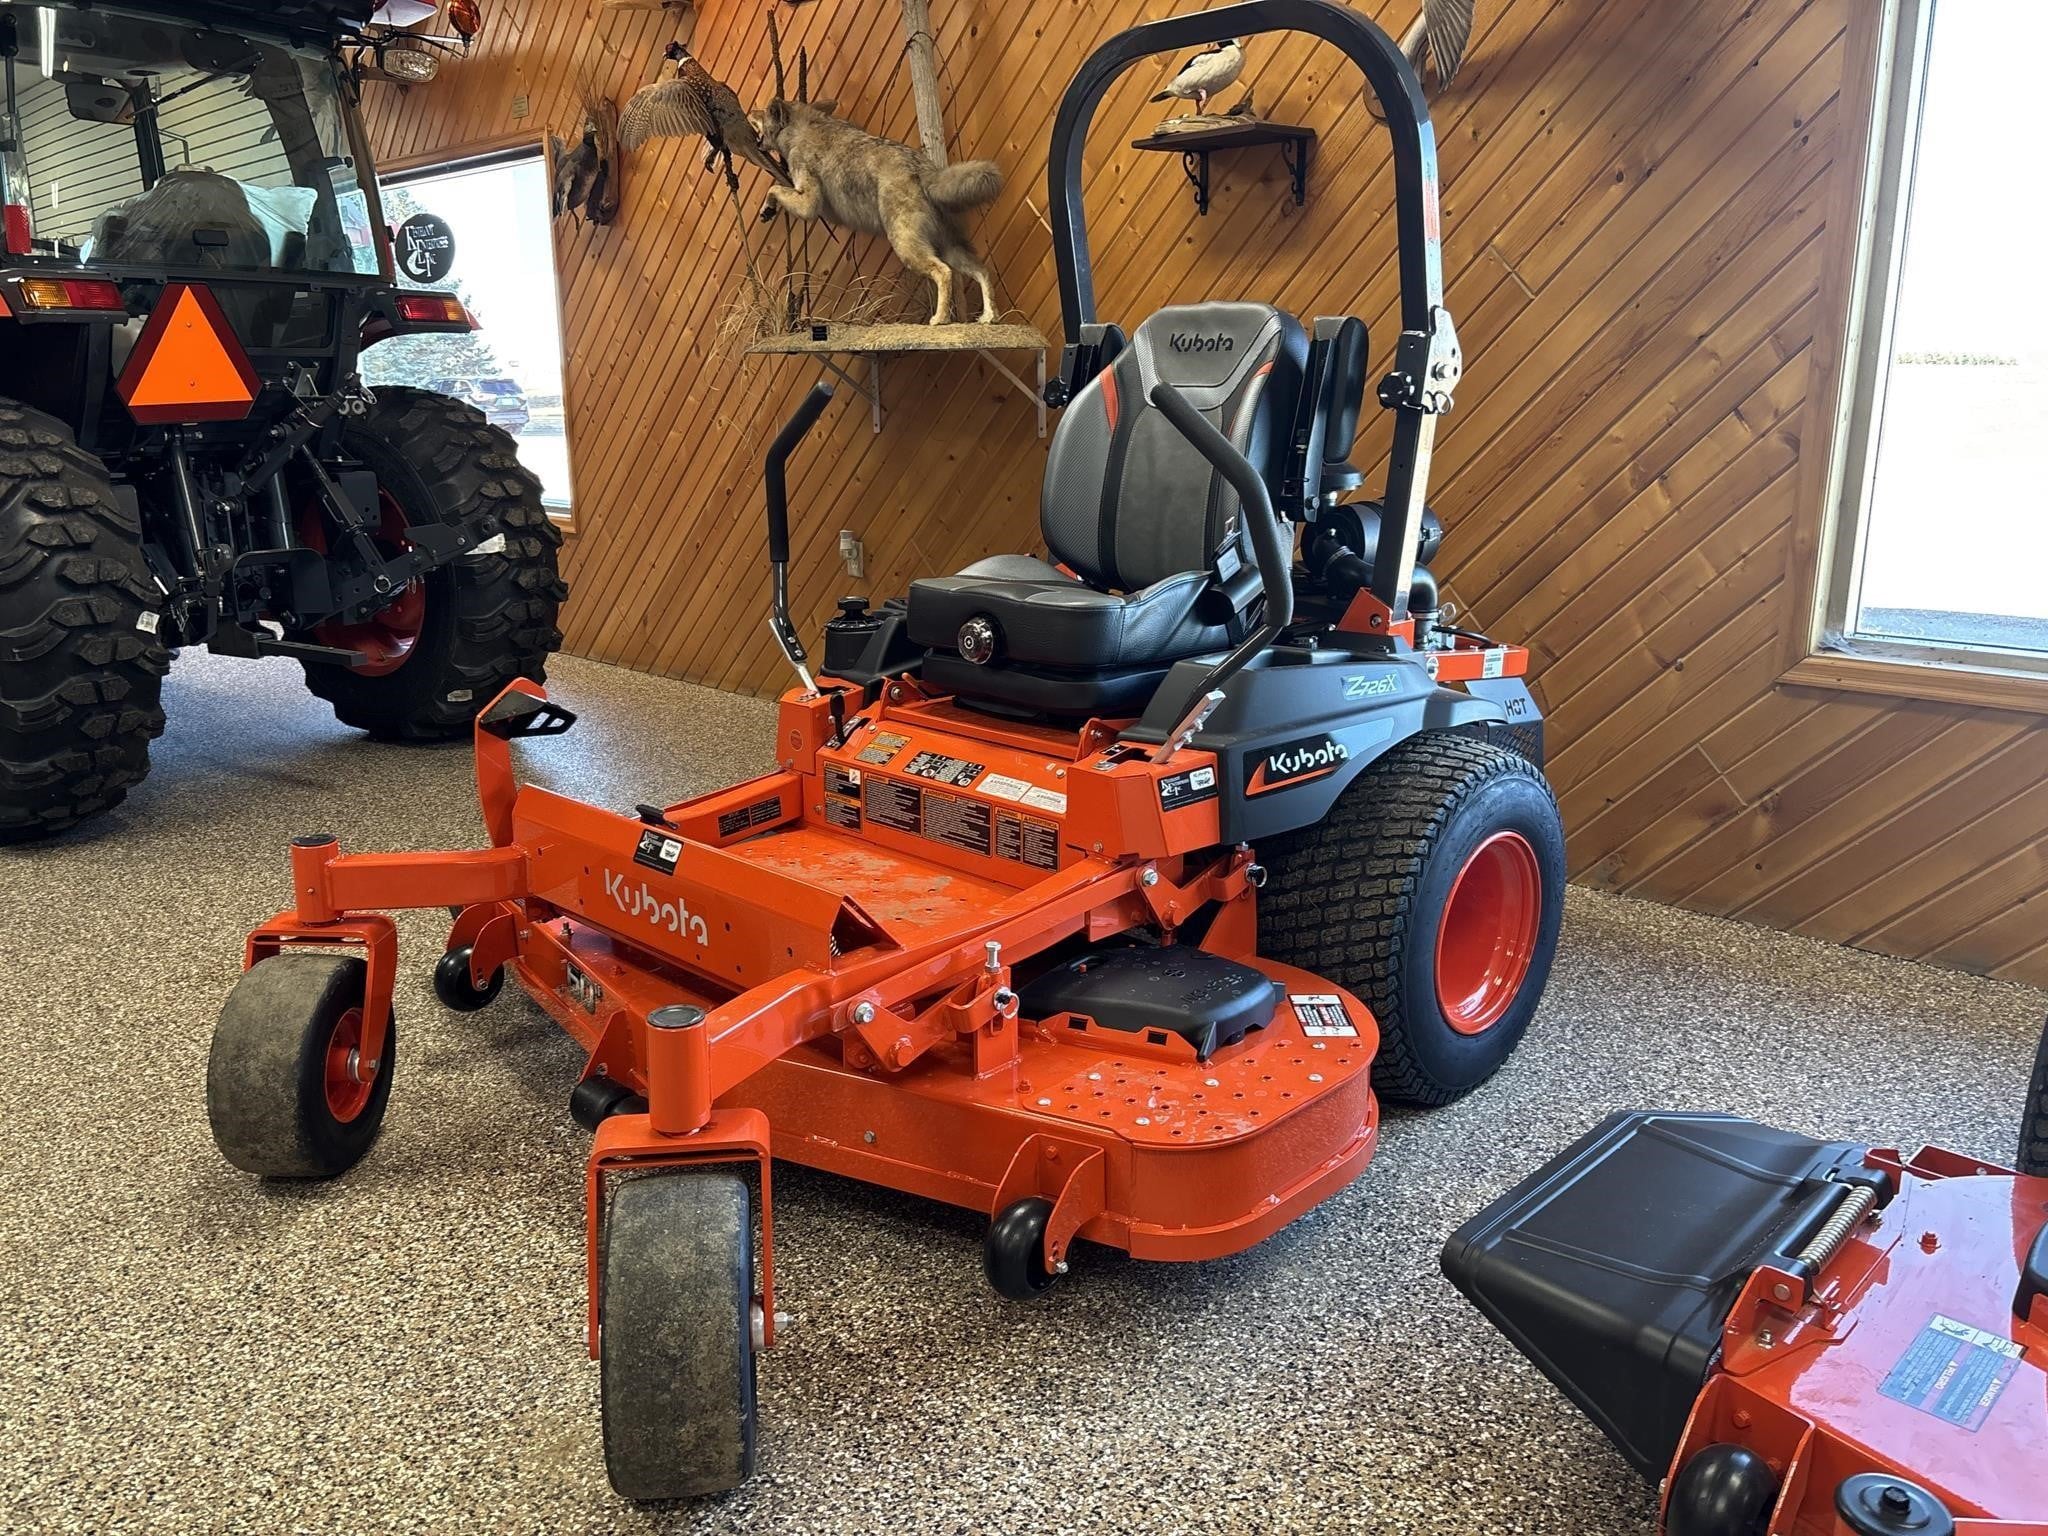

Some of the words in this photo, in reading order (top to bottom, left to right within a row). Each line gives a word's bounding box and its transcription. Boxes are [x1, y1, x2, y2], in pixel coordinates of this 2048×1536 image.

[1169, 332, 1234, 353] Kubota
[1346, 674, 1397, 696] Z726X
[1504, 698, 1527, 717] HOT
[1269, 741, 1349, 774] Kubota
[604, 868, 709, 947] Kubota
